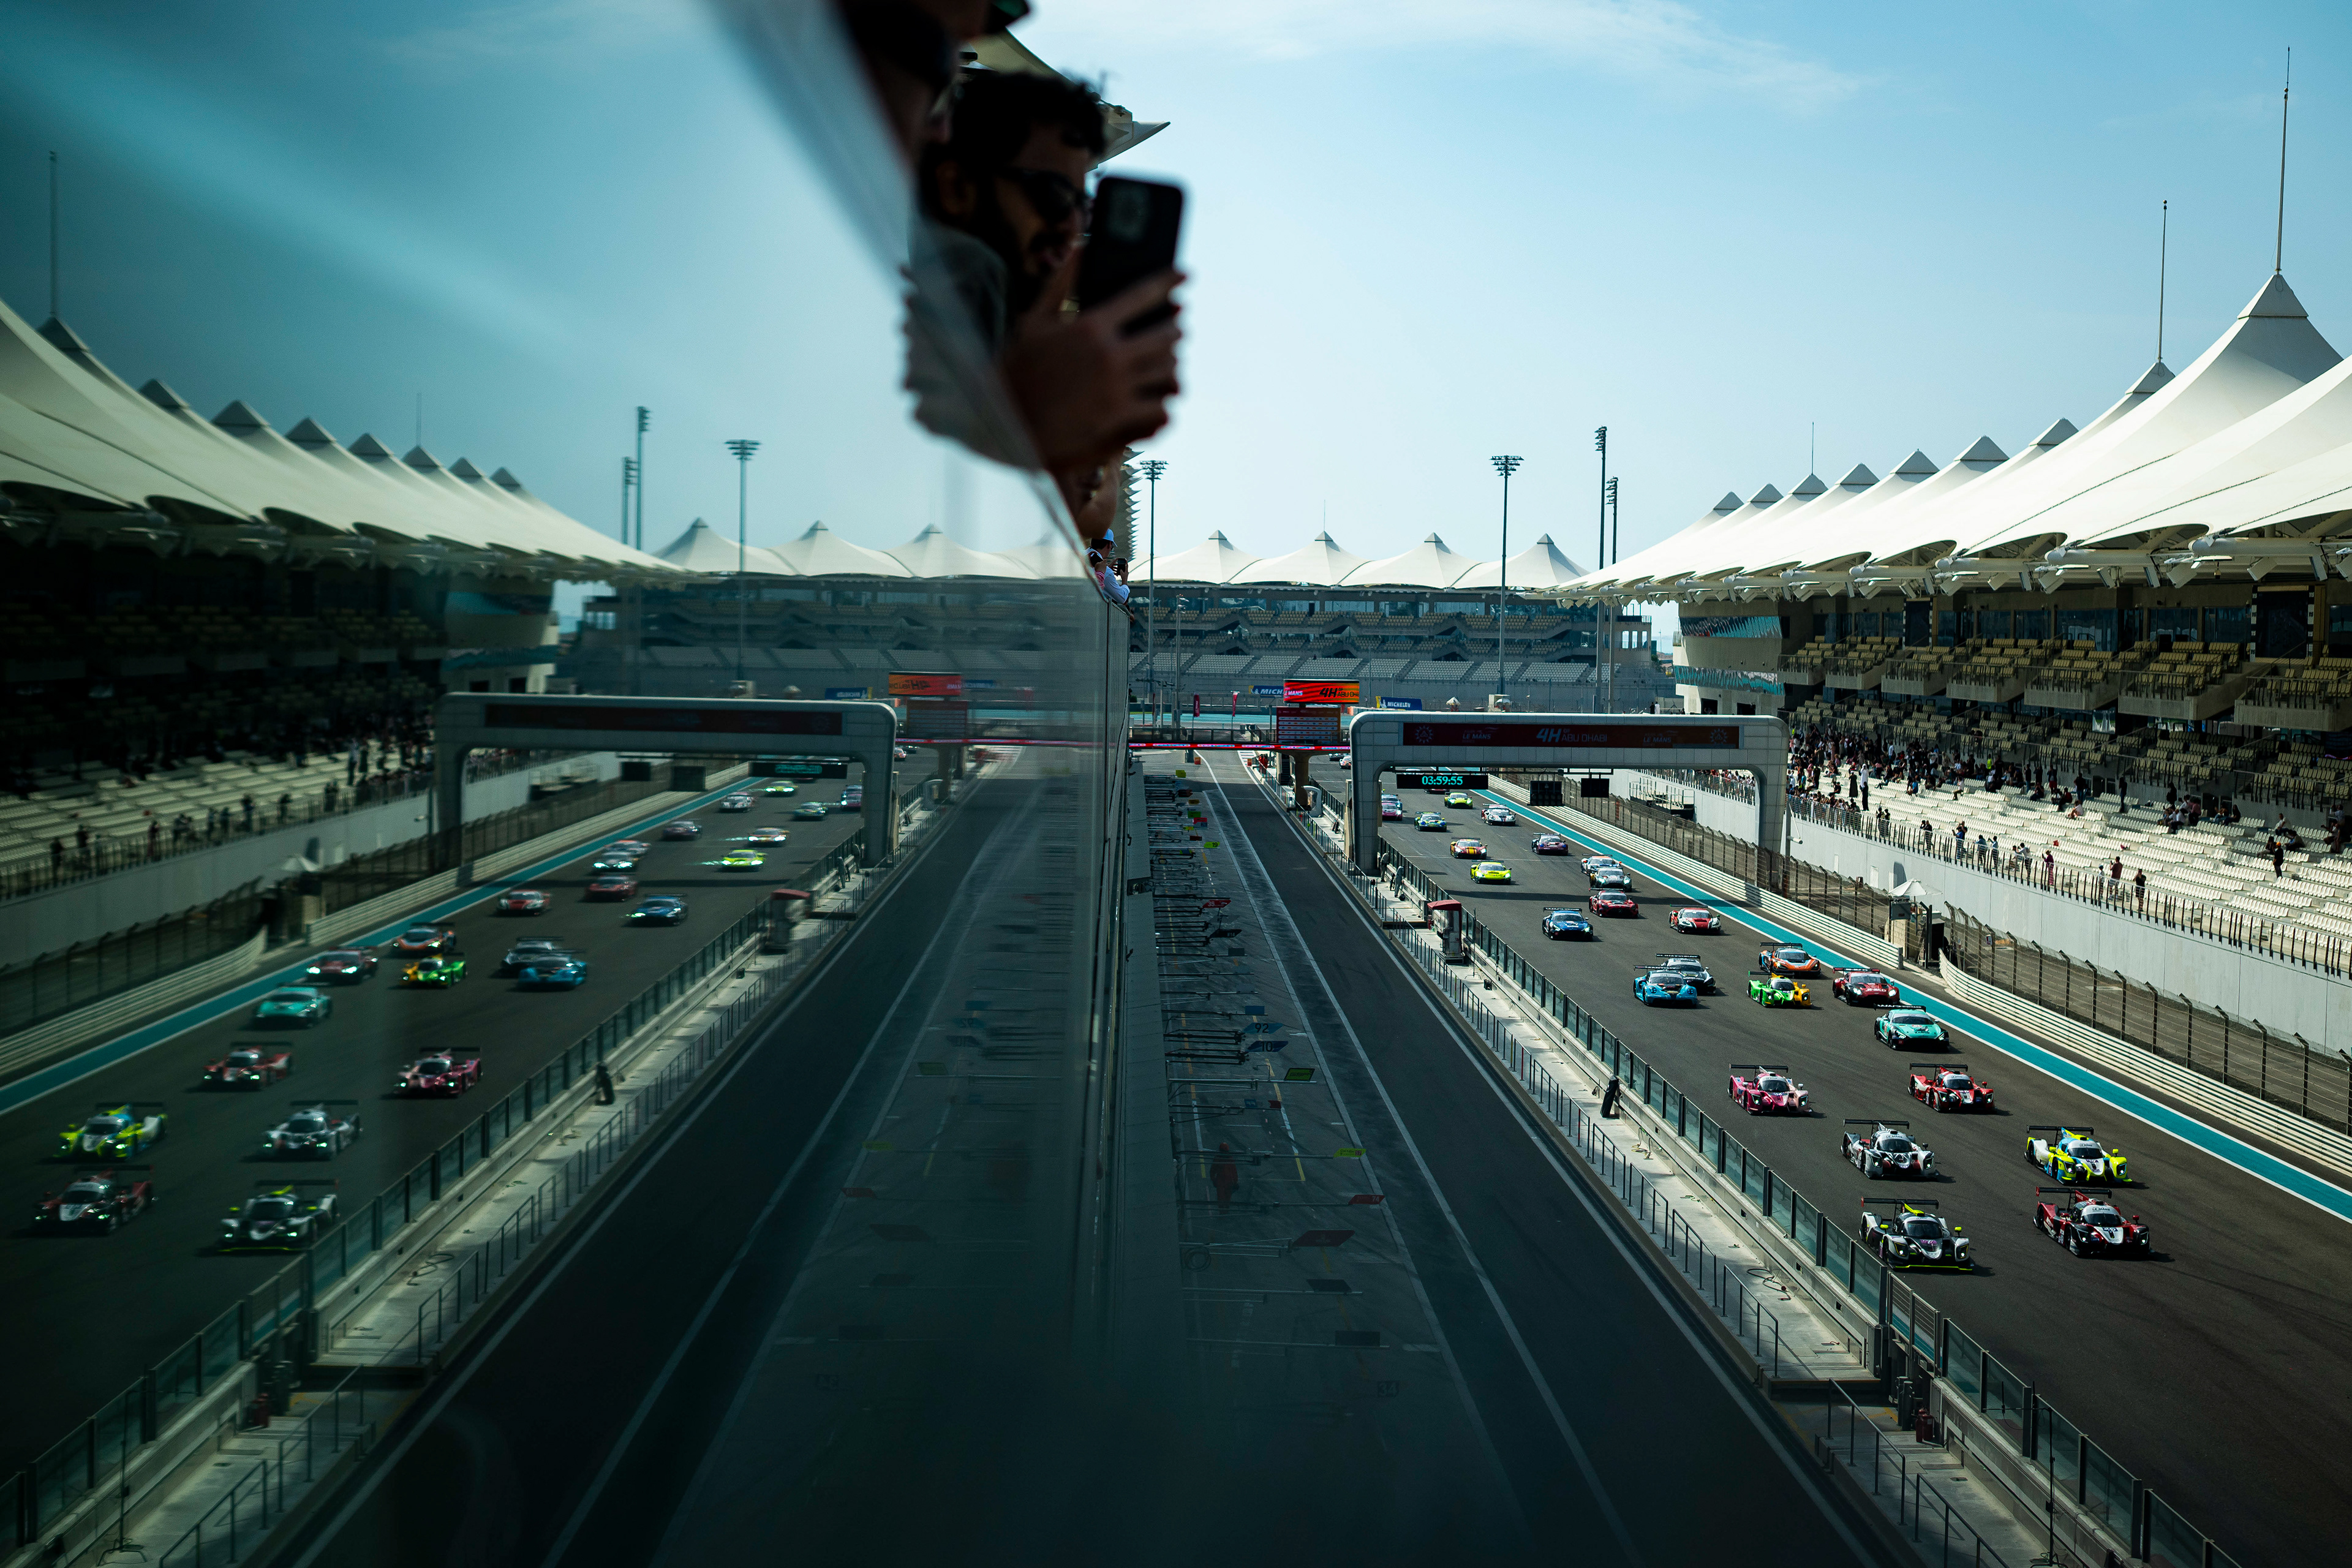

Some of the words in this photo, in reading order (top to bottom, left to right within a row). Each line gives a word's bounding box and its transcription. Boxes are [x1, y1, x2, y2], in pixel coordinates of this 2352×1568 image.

[1319, 687, 1338, 698] 4H
[1536, 728, 1562, 742] 4H
[1561, 734, 1580, 742] ABU
[1581, 734, 1607, 742] DHABI
[1422, 775, 1463, 785] 03:59:55
[1254, 1022, 1269, 1034] 92
[1260, 1041, 1273, 1052] 10
